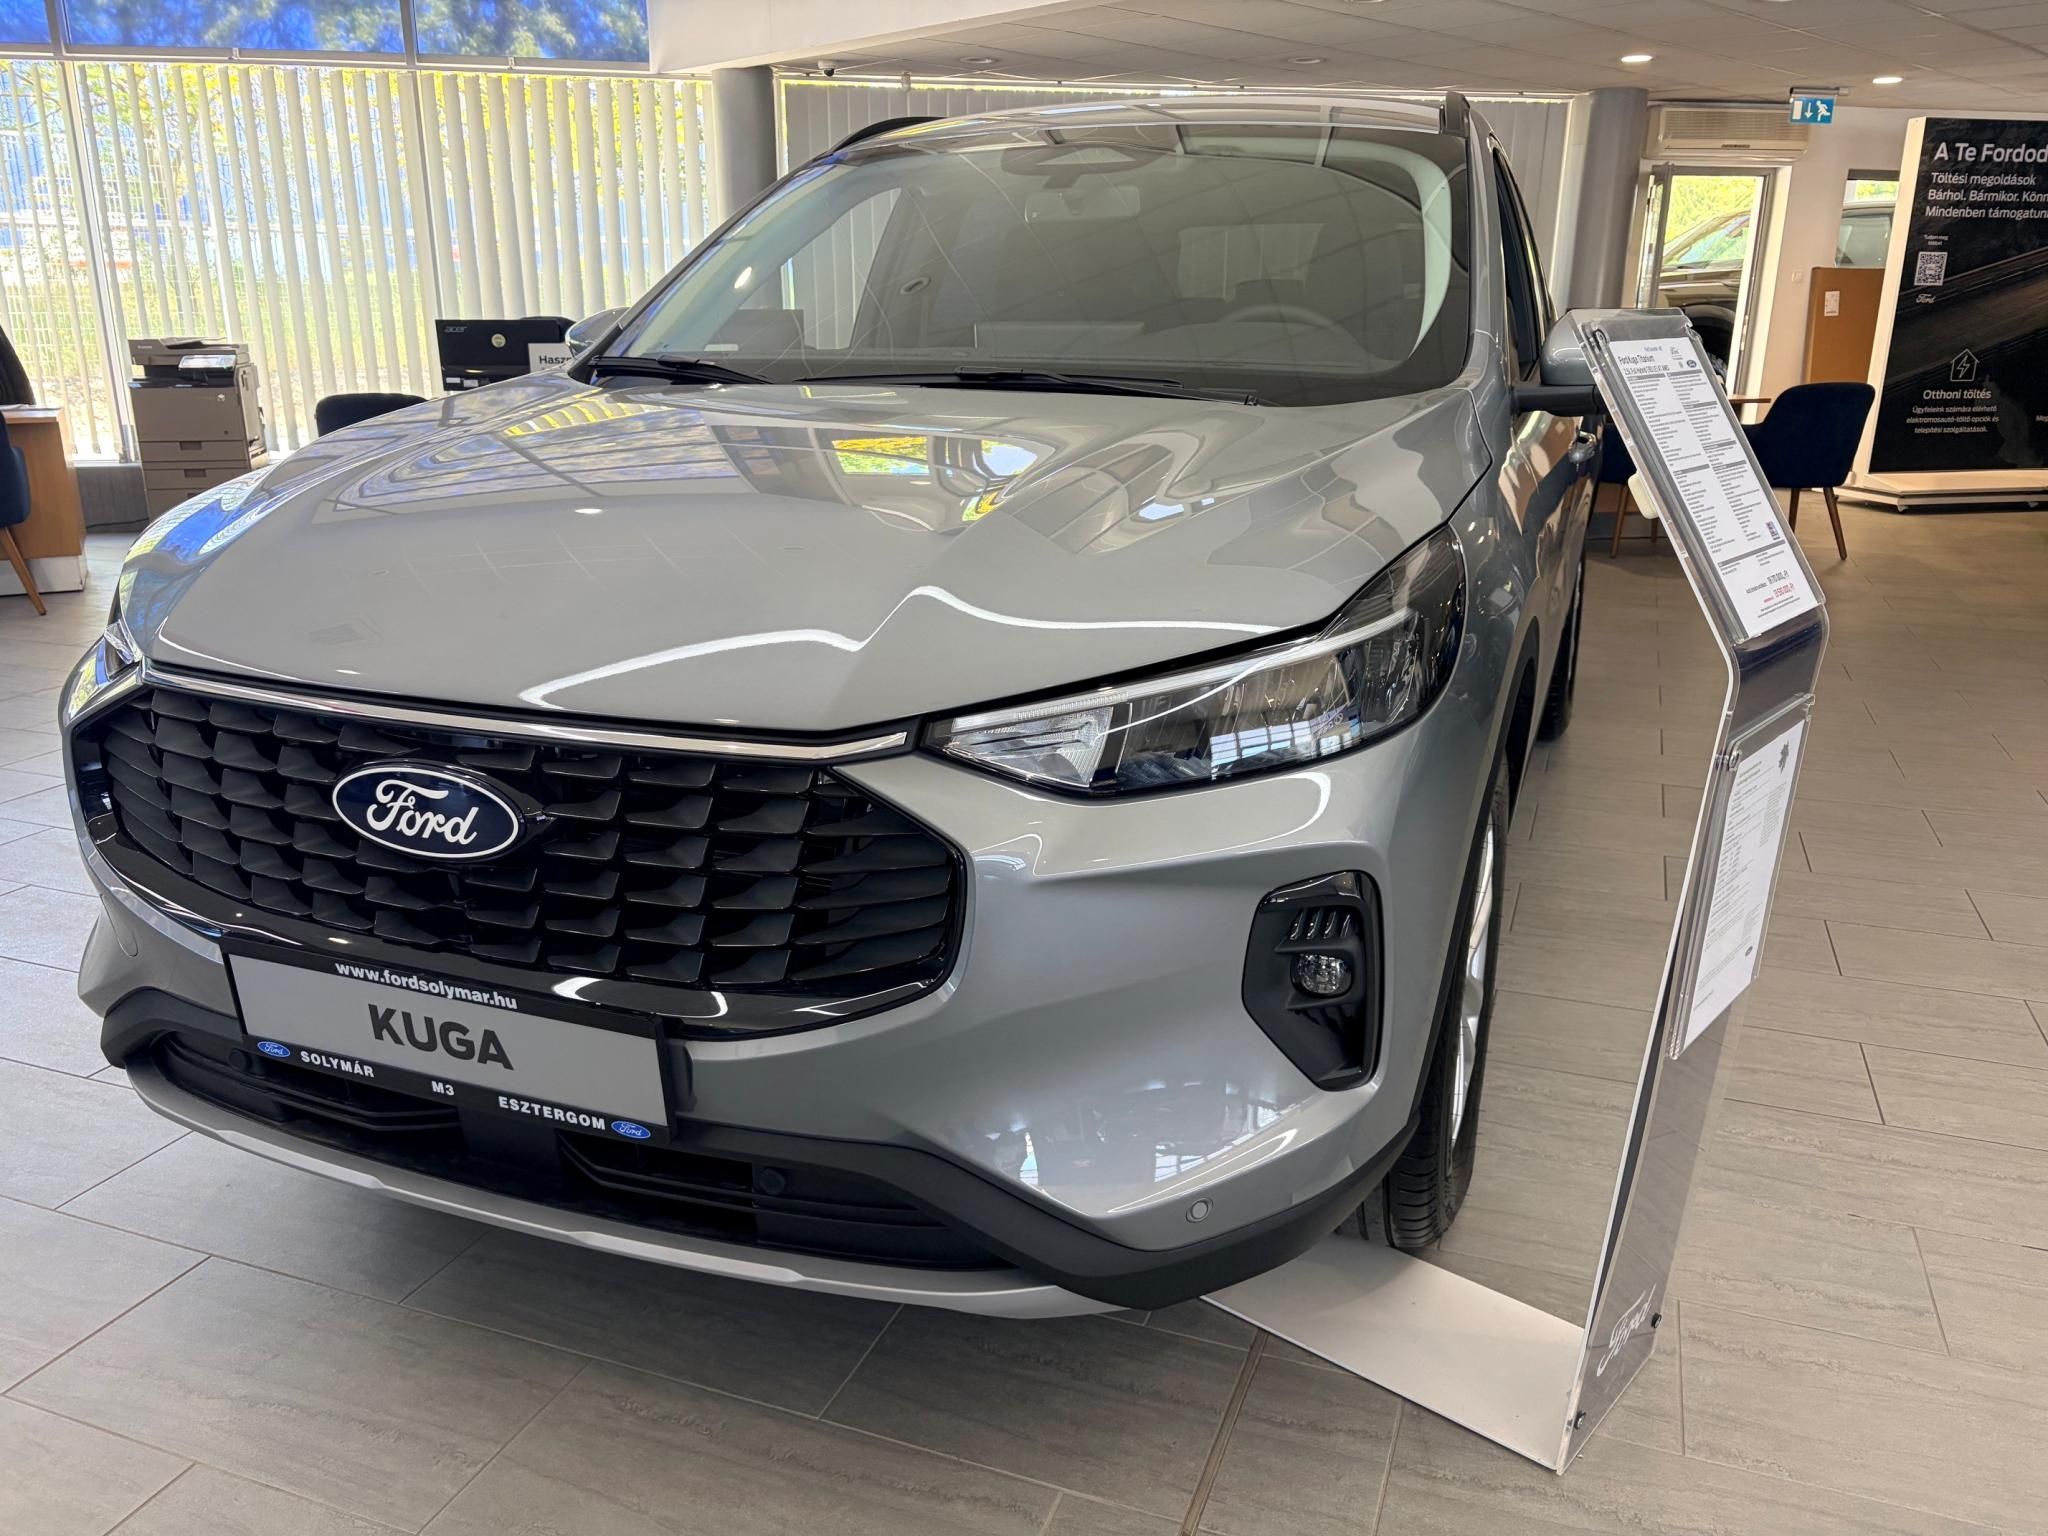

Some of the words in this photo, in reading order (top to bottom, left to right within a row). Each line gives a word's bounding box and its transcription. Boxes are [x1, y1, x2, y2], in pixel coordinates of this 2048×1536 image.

[1934, 142, 1949, 161] A
[1955, 143, 1977, 162] Te
[1980, 143, 2048, 163] Fordod
[1931, 172, 1968, 184] Töltési
[1969, 174, 2037, 187] megoldások
[1928, 189, 1966, 201] Bárhol.
[1969, 190, 2020, 202] Bármikor.
[1925, 206, 1985, 218] Mindenben
[1988, 207, 2048, 221] támogatun
[1923, 389, 1961, 400] Otthoni
[1963, 389, 1992, 399] töltés
[366, 779, 479, 845] Ford
[335, 963, 518, 1010] www.fordsolymar.hu
[368, 1004, 514, 1071] KUGA
[300, 1050, 375, 1078] SOLYMÁR
[432, 1081, 455, 1096] M3
[498, 1096, 606, 1130] ESZTERGOM
